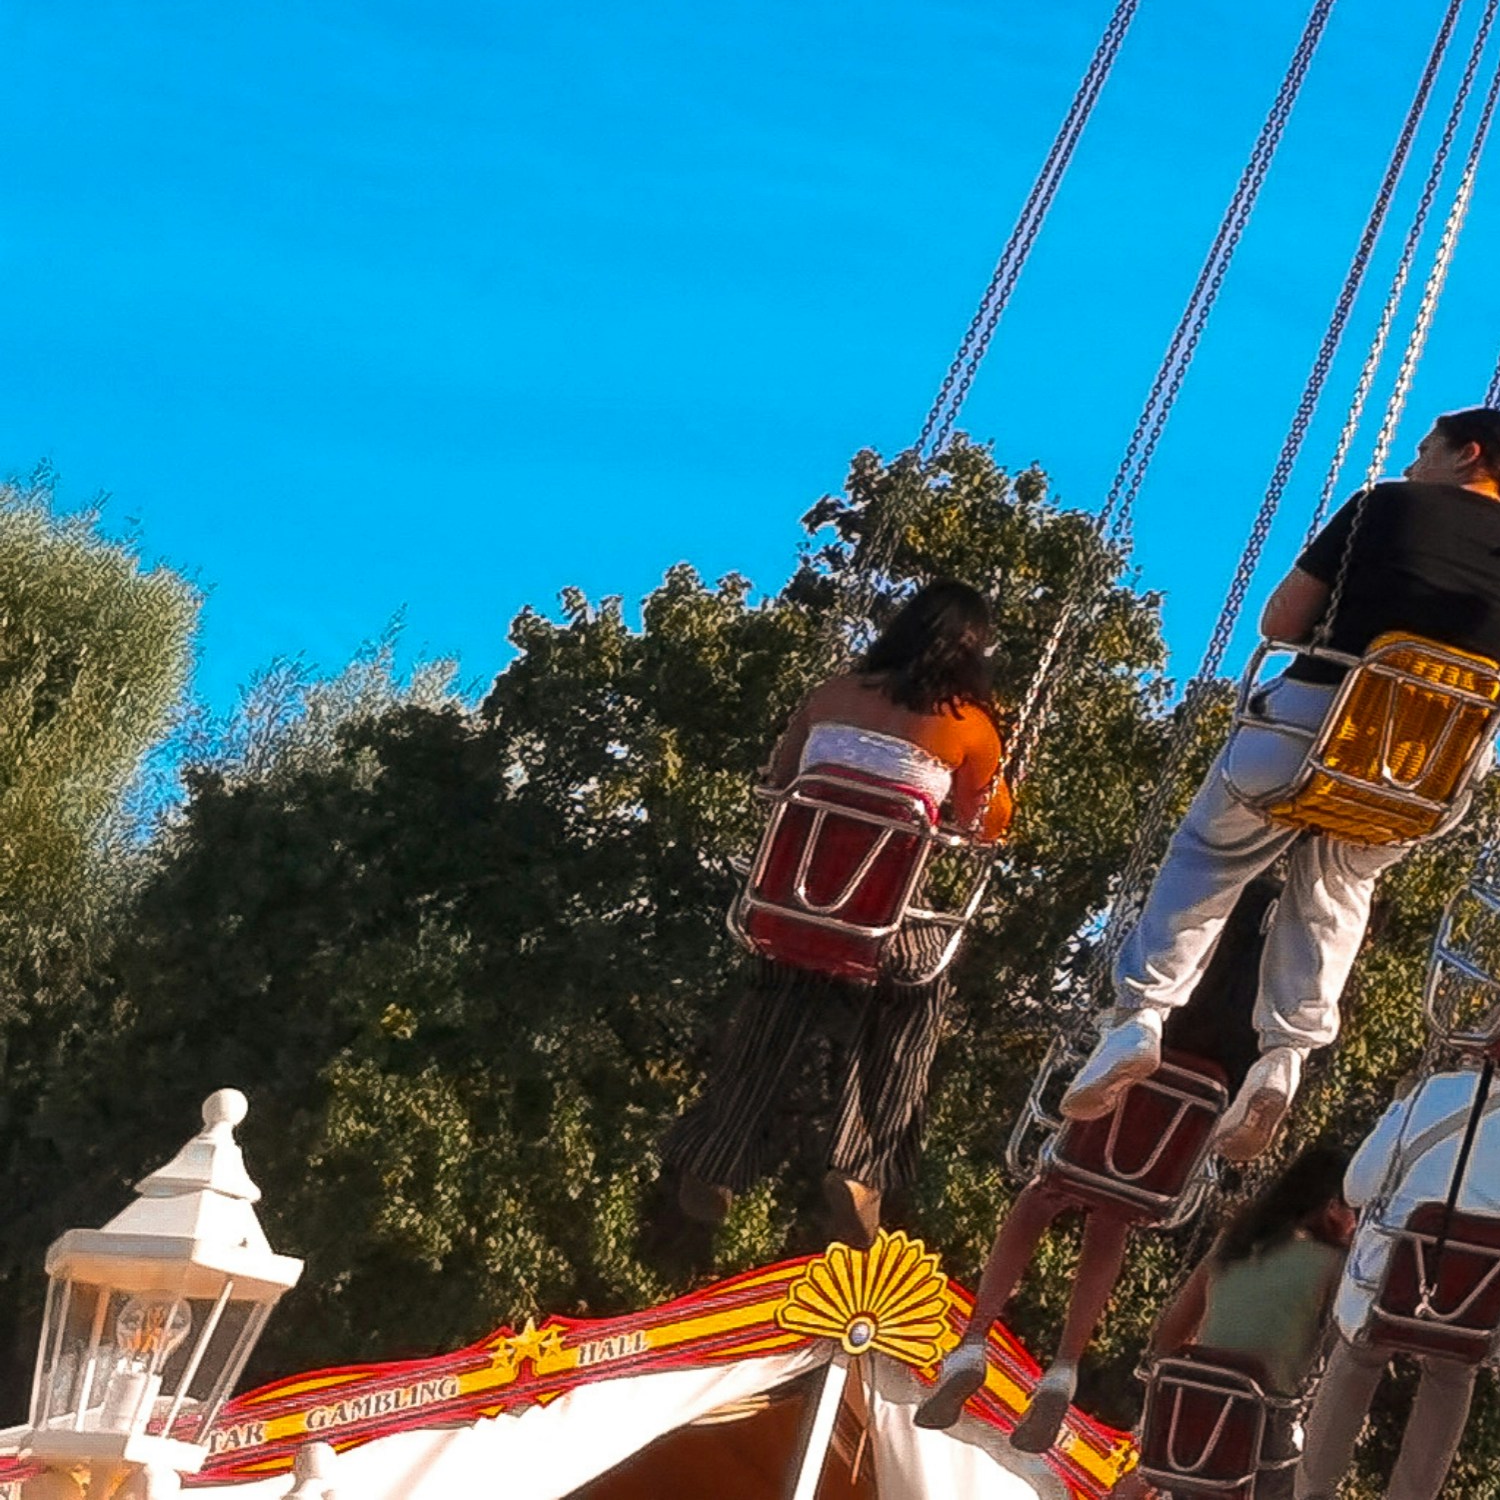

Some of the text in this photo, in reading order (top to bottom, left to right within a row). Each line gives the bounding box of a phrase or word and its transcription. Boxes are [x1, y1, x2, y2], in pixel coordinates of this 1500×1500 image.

[207, 1331, 649, 1454] TAR GAMBLING HALL
